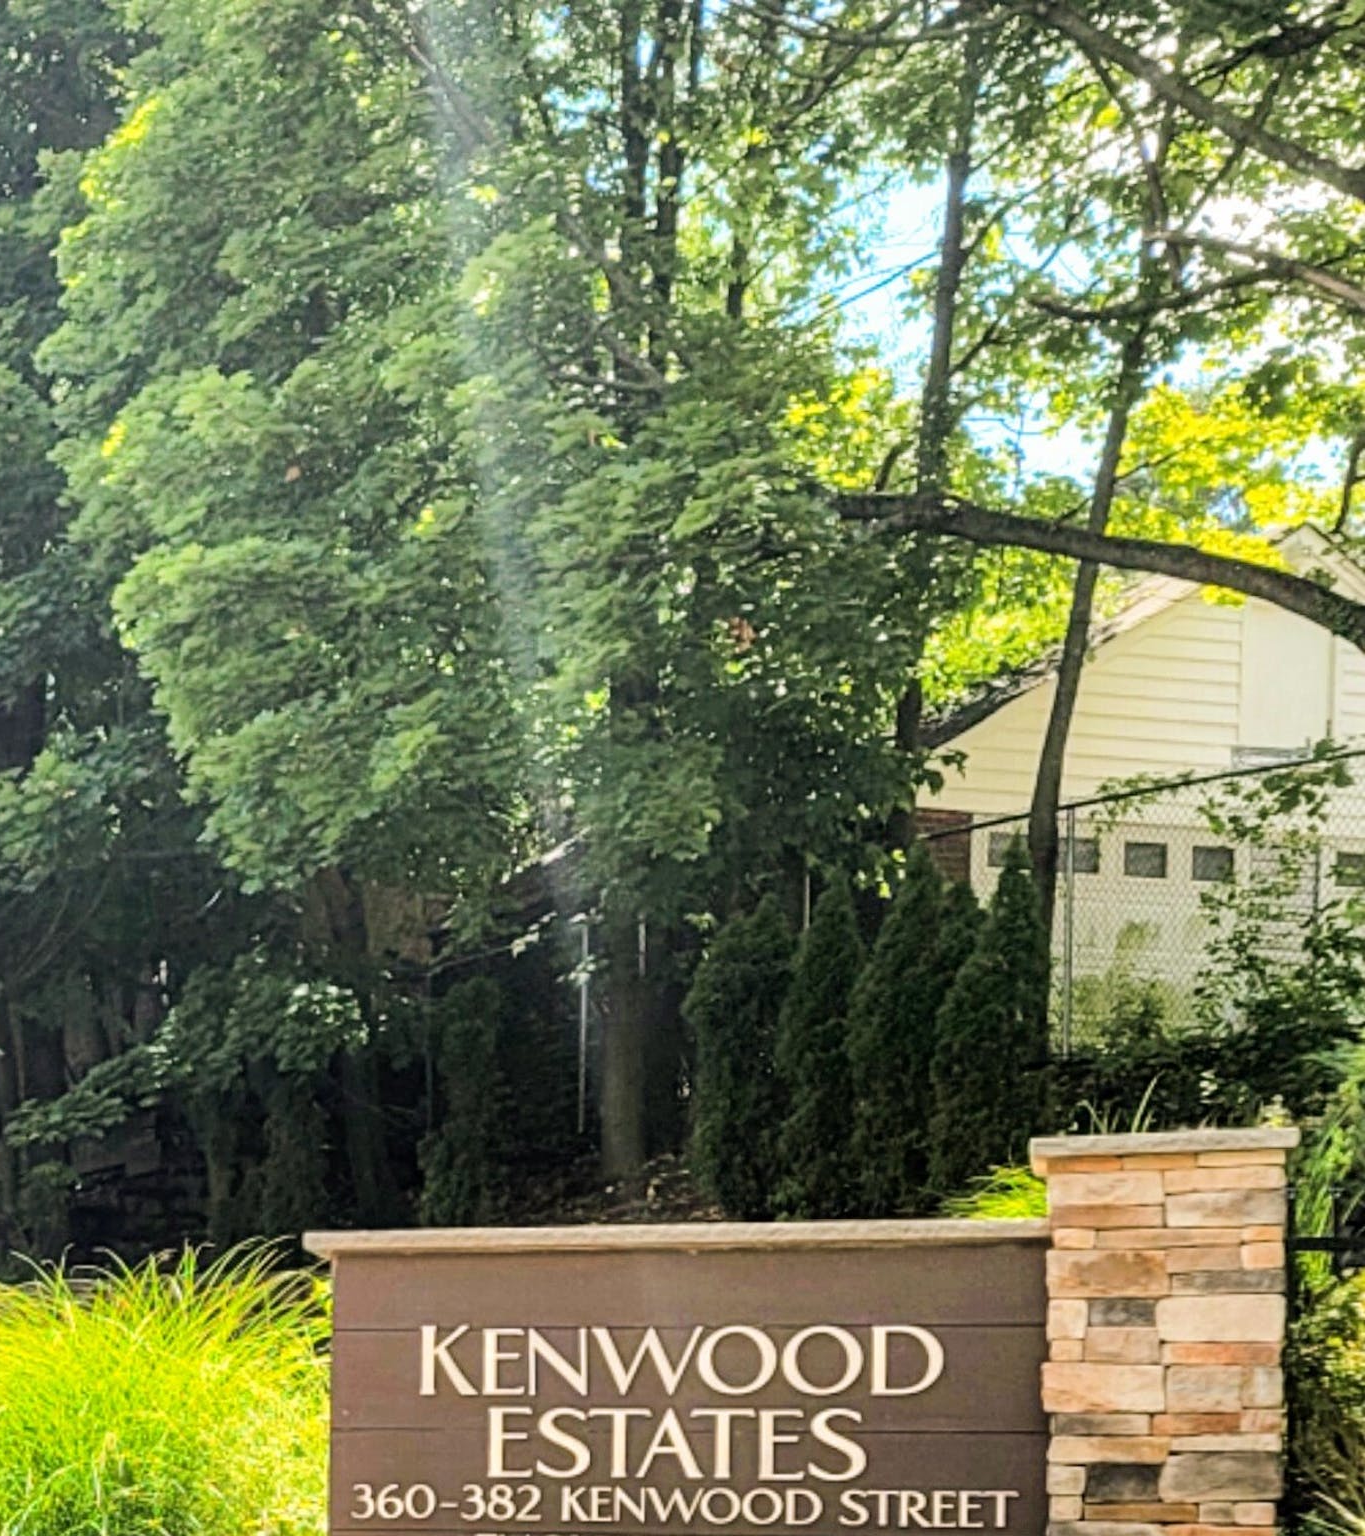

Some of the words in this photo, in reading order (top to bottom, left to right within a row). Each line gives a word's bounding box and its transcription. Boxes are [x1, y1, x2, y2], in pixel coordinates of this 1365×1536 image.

[419, 1324, 945, 1397] KENWOOD
[486, 1407, 868, 1481] ESTATES
[350, 1484, 541, 1522] 360-382
[560, 1486, 823, 1526] KENWOOD
[839, 1489, 1019, 1529] STREET
